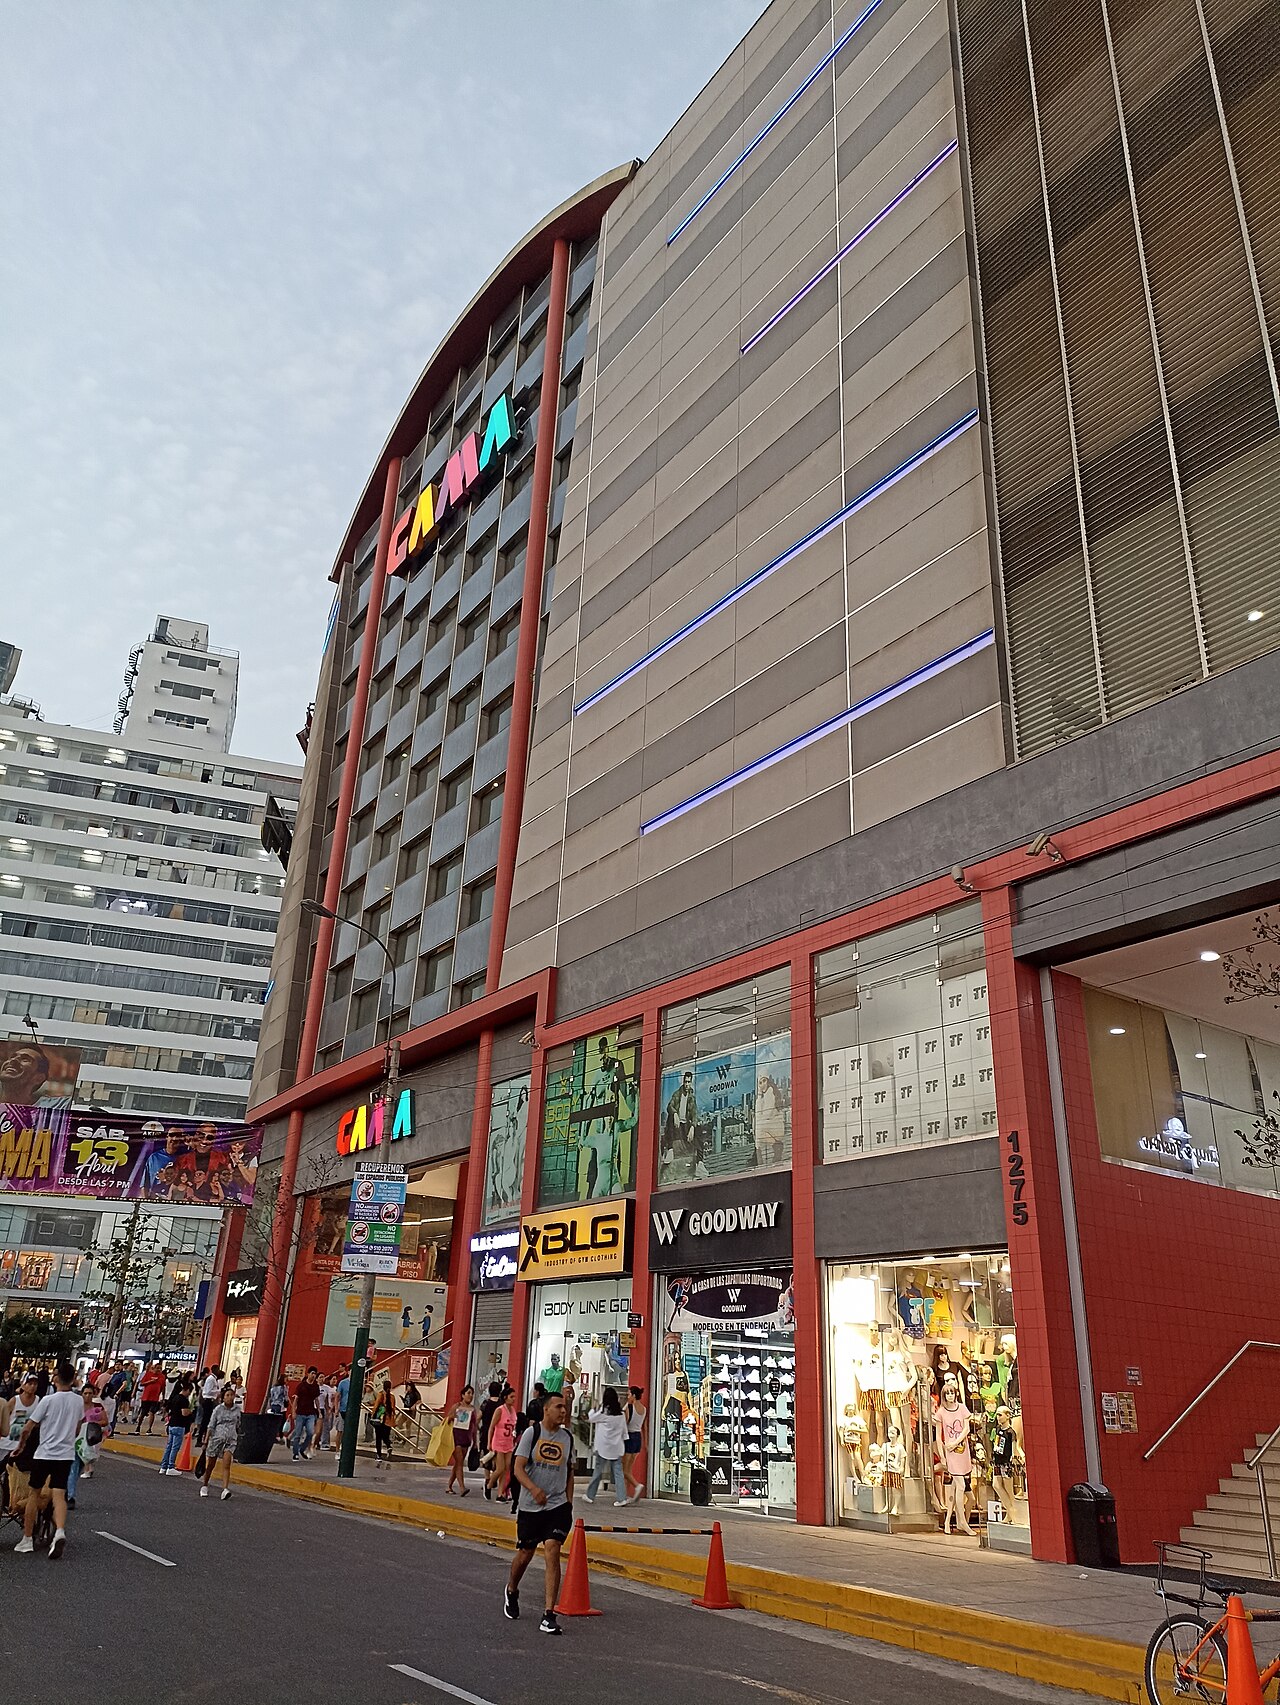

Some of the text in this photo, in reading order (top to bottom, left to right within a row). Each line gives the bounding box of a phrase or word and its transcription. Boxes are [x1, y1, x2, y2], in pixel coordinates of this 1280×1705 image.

[710, 1080, 738, 1093] GOODWAY
[76, 1126, 130, 1140] SÁB.
[71, 1140, 130, 1167] 13
[75, 1152, 119, 1178] Abril
[360, 1162, 404, 1174] RECUPEREMOS
[58, 1177, 88, 1186] DESDE
[89, 1179, 107, 1188] LAS
[116, 1180, 131, 1189] PM
[1007, 1131, 1028, 1226] 1275
[689, 1202, 780, 1236] GOODWAY
[542, 1214, 620, 1256] BLG
[544, 1258, 568, 1267] INDUSTRY
[590, 1253, 618, 1262] CLOTHING
[402, 1270, 418, 1278] PISO
[544, 1302, 574, 1316] BODY
[580, 1300, 606, 1314] LINE
[722, 1304, 746, 1313] GOODWAY
[692, 1321, 776, 1331] MODELOS EN TENDENCIA
